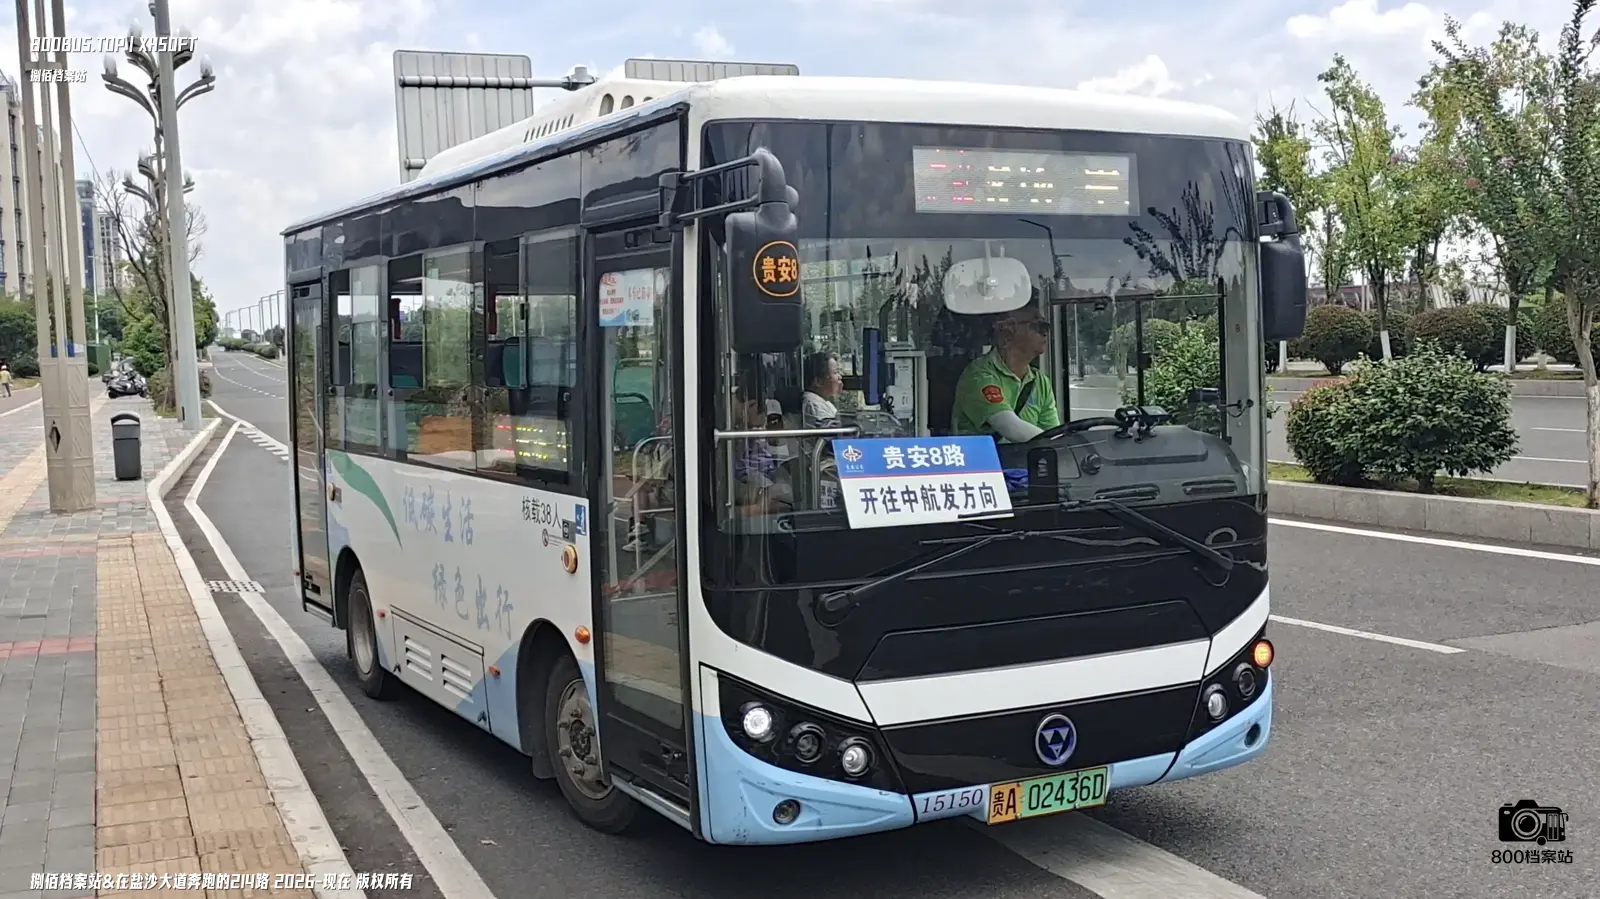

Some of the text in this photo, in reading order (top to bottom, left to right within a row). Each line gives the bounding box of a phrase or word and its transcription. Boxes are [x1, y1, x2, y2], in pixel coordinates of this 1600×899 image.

[762, 256, 797, 283] 贵安8
[883, 444, 966, 470] 贵安8路
[522, 496, 562, 530] 核载38人
[860, 482, 998, 515] 开往中航发方向
[432, 561, 514, 641] 绿色出行
[920, 788, 984, 815] 15150
